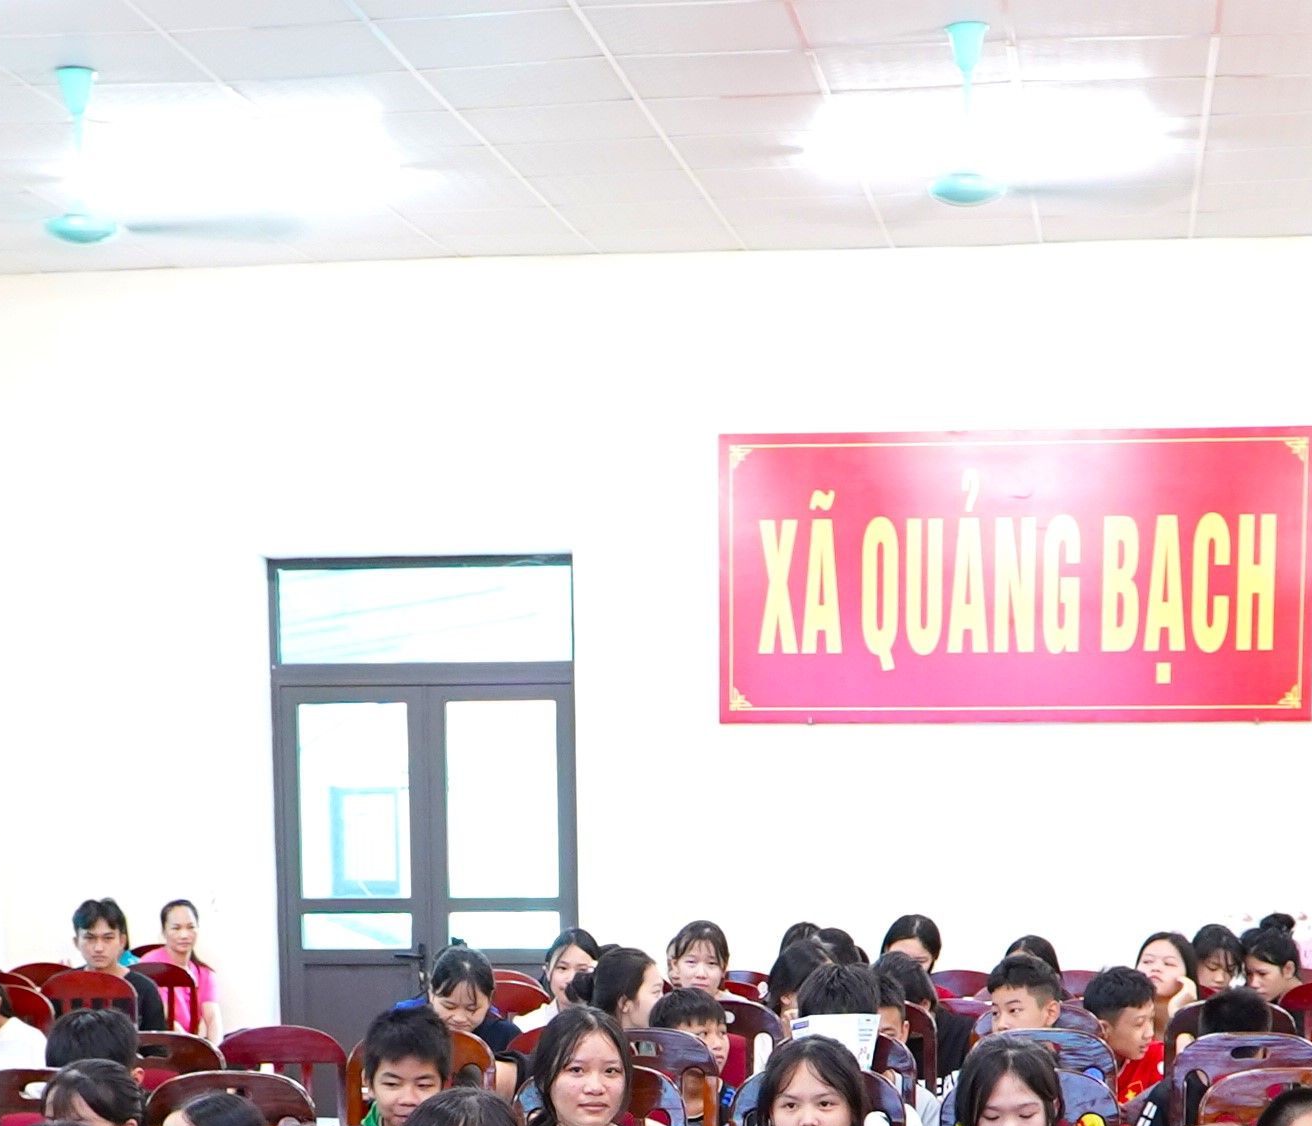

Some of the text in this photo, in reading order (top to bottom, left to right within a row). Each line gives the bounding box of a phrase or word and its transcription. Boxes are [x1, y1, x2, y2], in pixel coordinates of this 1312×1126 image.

[757, 466, 1278, 685] XÃ QUẢNG BẠCH
